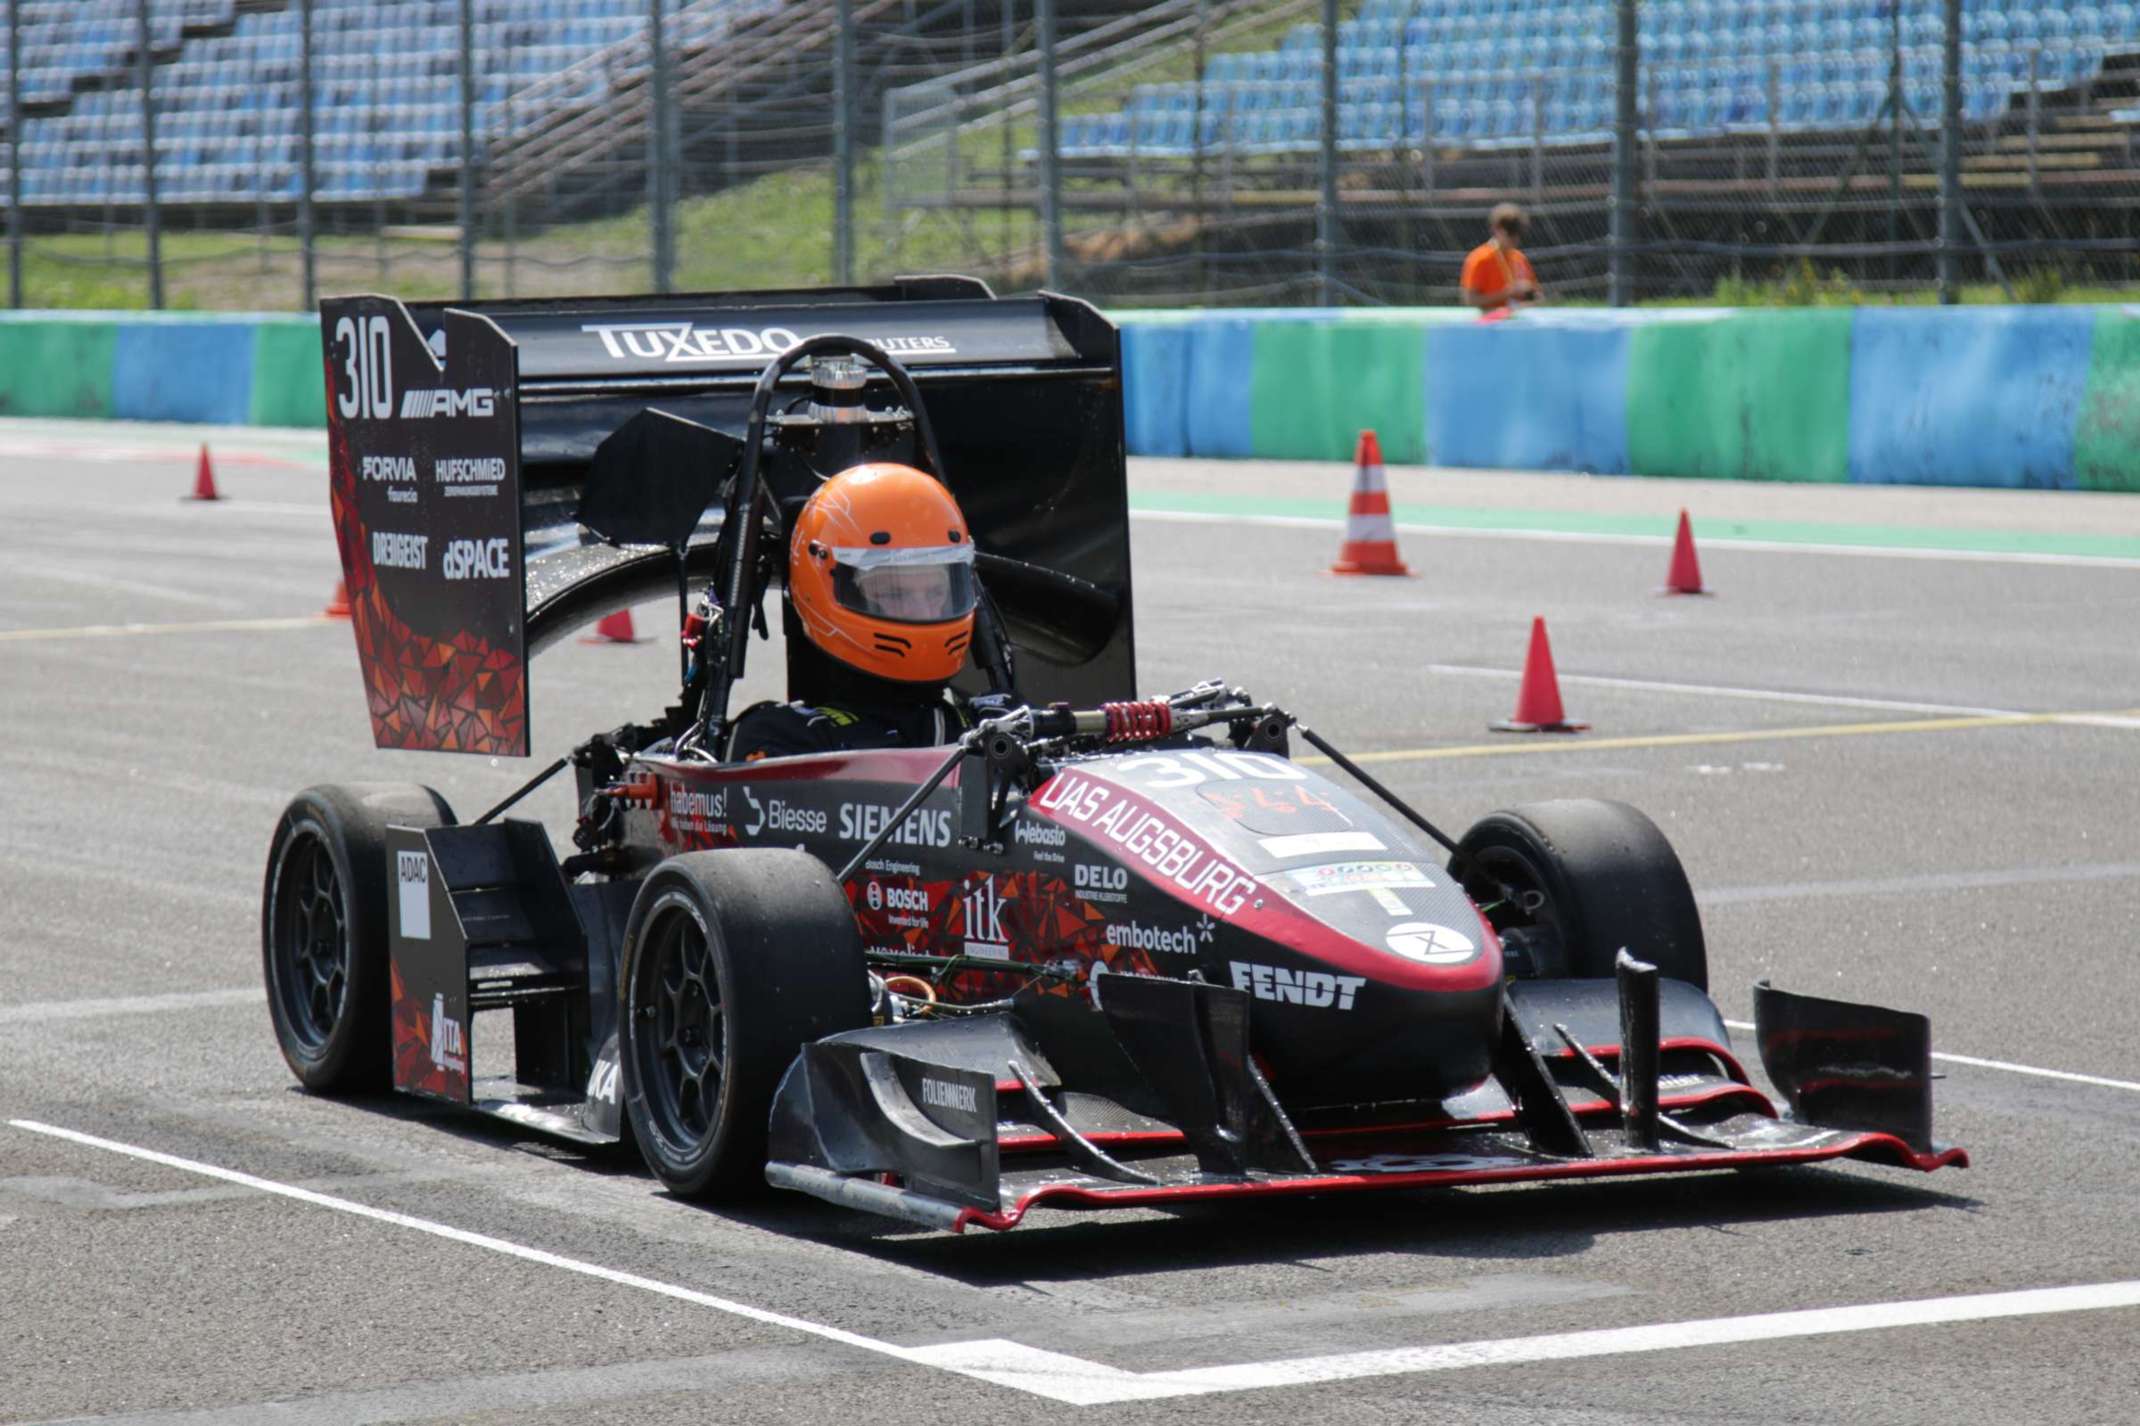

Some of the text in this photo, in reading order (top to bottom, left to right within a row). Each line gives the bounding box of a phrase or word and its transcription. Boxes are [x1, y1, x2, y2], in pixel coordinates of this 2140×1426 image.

[581, 322, 801, 362] TUXEDO
[336, 316, 393, 419] 310
[429, 387, 494, 418] AMG
[362, 456, 417, 482] FORVIA
[443, 538, 511, 580] dSPACE
[1117, 752, 1309, 788] 310
[768, 800, 827, 833] Biesse
[839, 802, 951, 848] SIEMENS
[1014, 819, 1066, 847] Webasto
[1039, 772, 1111, 822] UAS
[1092, 800, 1258, 916] AUGSBURG
[400, 855, 427, 884] ADAC
[1074, 864, 1128, 890] DELO
[886, 887, 929, 912] BOSCH
[963, 873, 1009, 942] itk
[1106, 920, 1196, 954] embotech
[1229, 960, 1366, 1010] FENDT
[922, 1078, 977, 1113] FOLIENWERK
